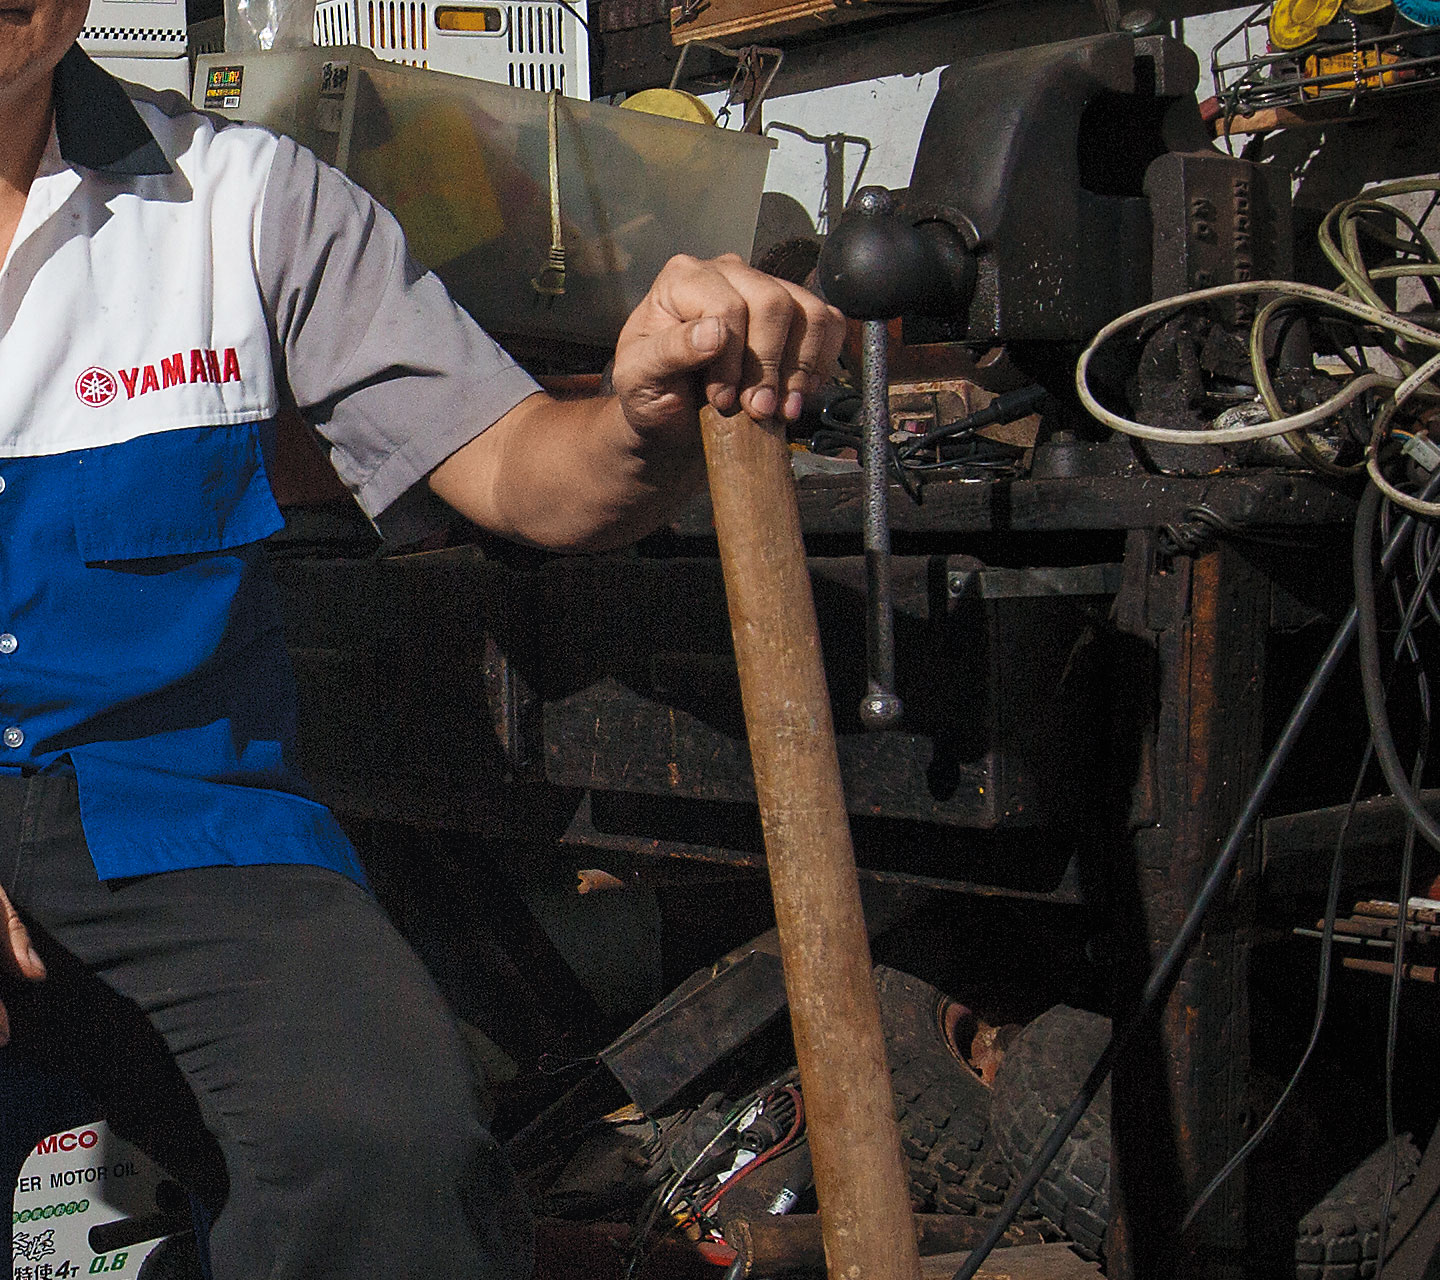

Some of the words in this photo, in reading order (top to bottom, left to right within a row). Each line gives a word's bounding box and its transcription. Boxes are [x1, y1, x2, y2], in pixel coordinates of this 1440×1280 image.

[118, 348, 242, 400] YAMAHA
[36, 1130, 98, 1155] MCO
[50, 1167, 107, 1188] MOTOR
[114, 1162, 138, 1179] OIL
[89, 1252, 128, 1275] 0.8
